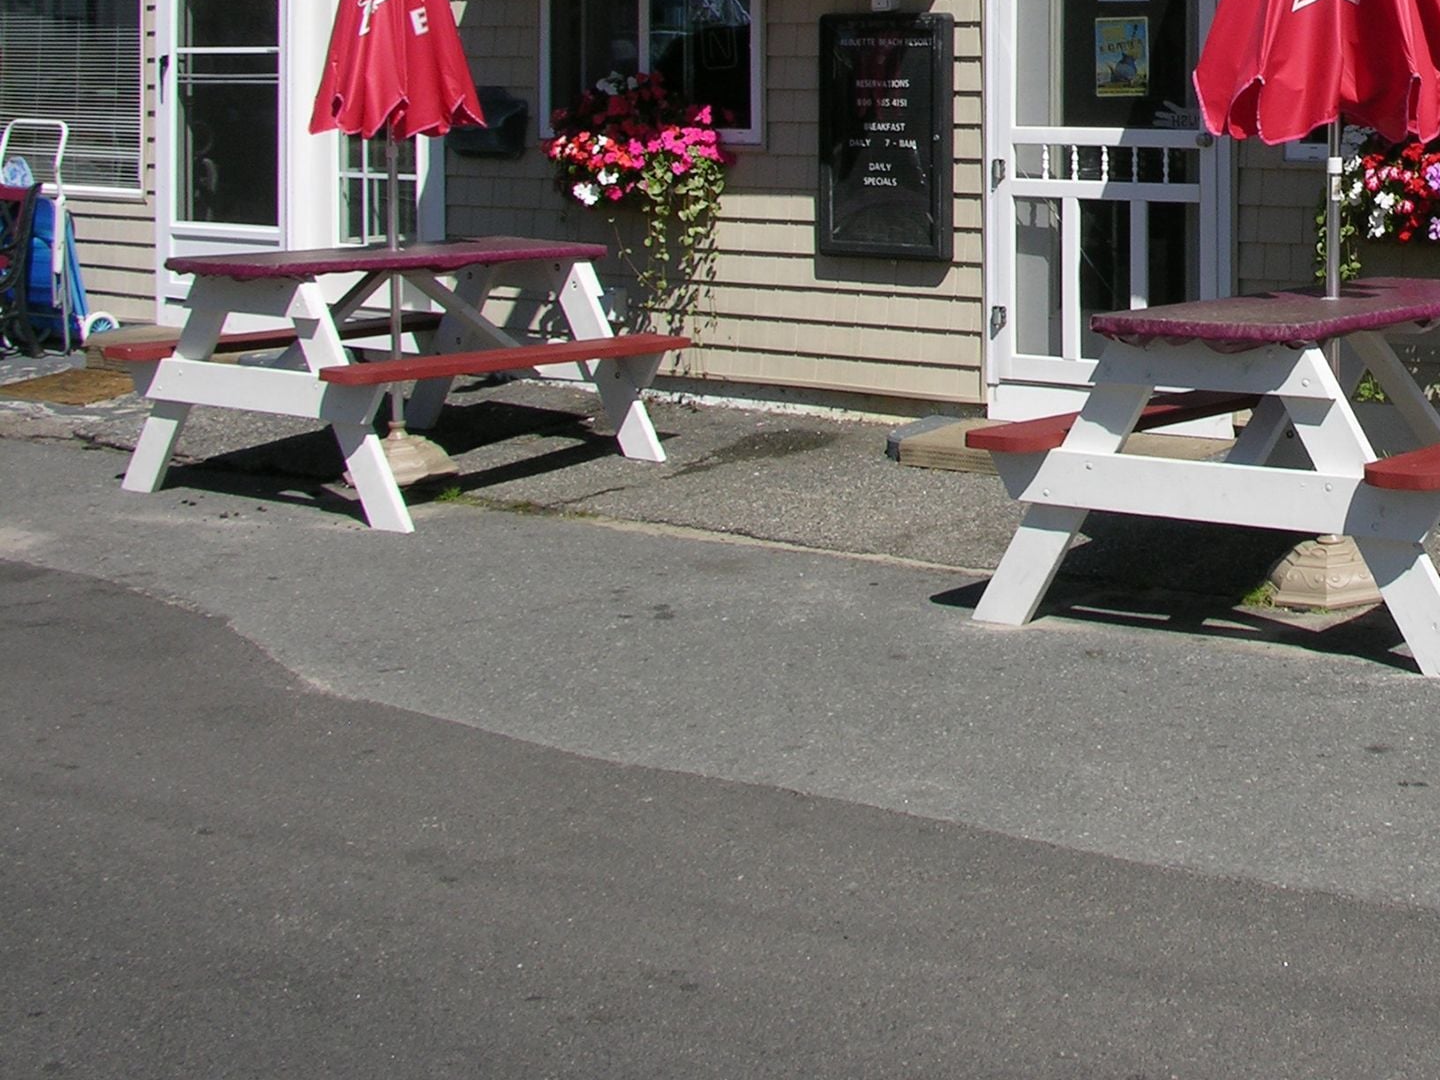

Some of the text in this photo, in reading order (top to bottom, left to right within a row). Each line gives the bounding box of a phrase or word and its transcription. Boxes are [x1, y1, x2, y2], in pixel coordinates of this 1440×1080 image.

[856, 79, 911, 89] RESERVATIONS
[864, 122, 906, 132] BREAKFAST
[849, 138, 872, 148] DAILY
[884, 138, 891, 148] 7
[868, 162, 892, 172] DAILY
[863, 176, 898, 187] SPECIALS
